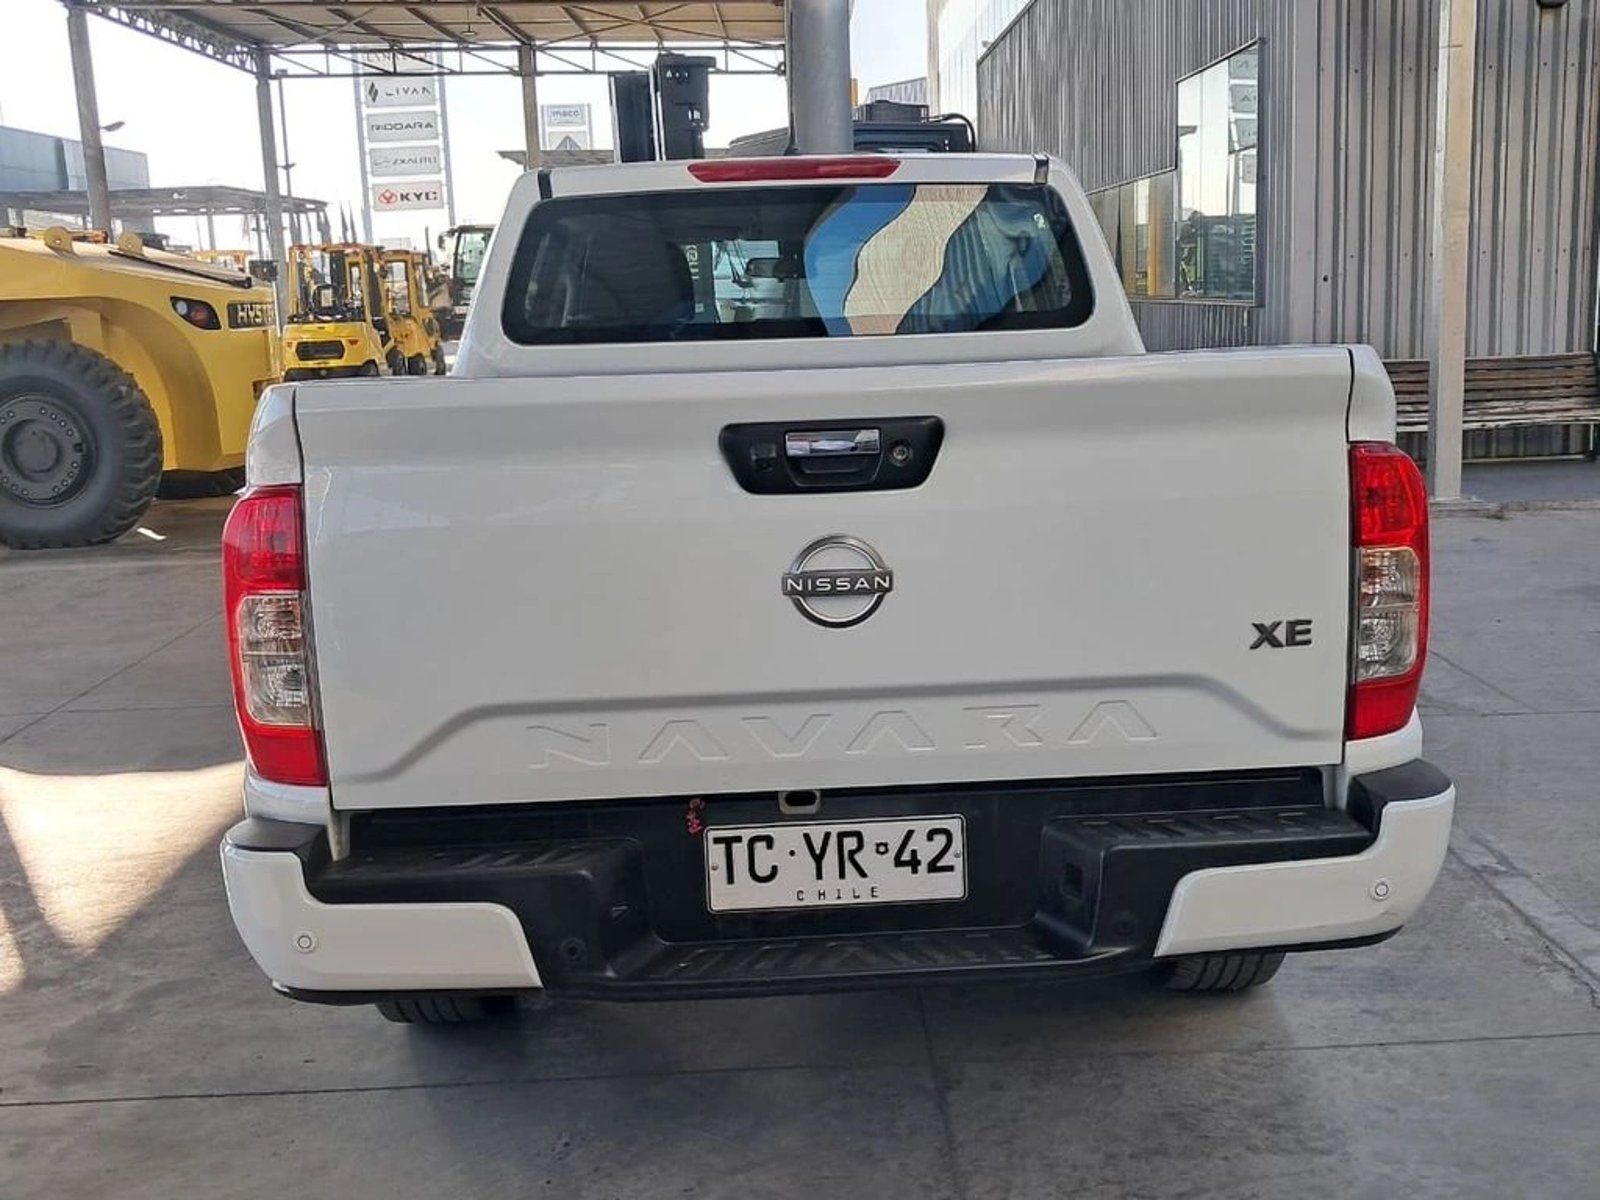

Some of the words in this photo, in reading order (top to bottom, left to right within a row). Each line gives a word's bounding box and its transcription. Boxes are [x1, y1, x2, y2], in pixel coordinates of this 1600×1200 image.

[786, 576, 890, 592] NISSAN
[1249, 619, 1312, 650] XE
[526, 700, 1158, 770] NAVARA
[796, 886, 878, 901] CHILE
